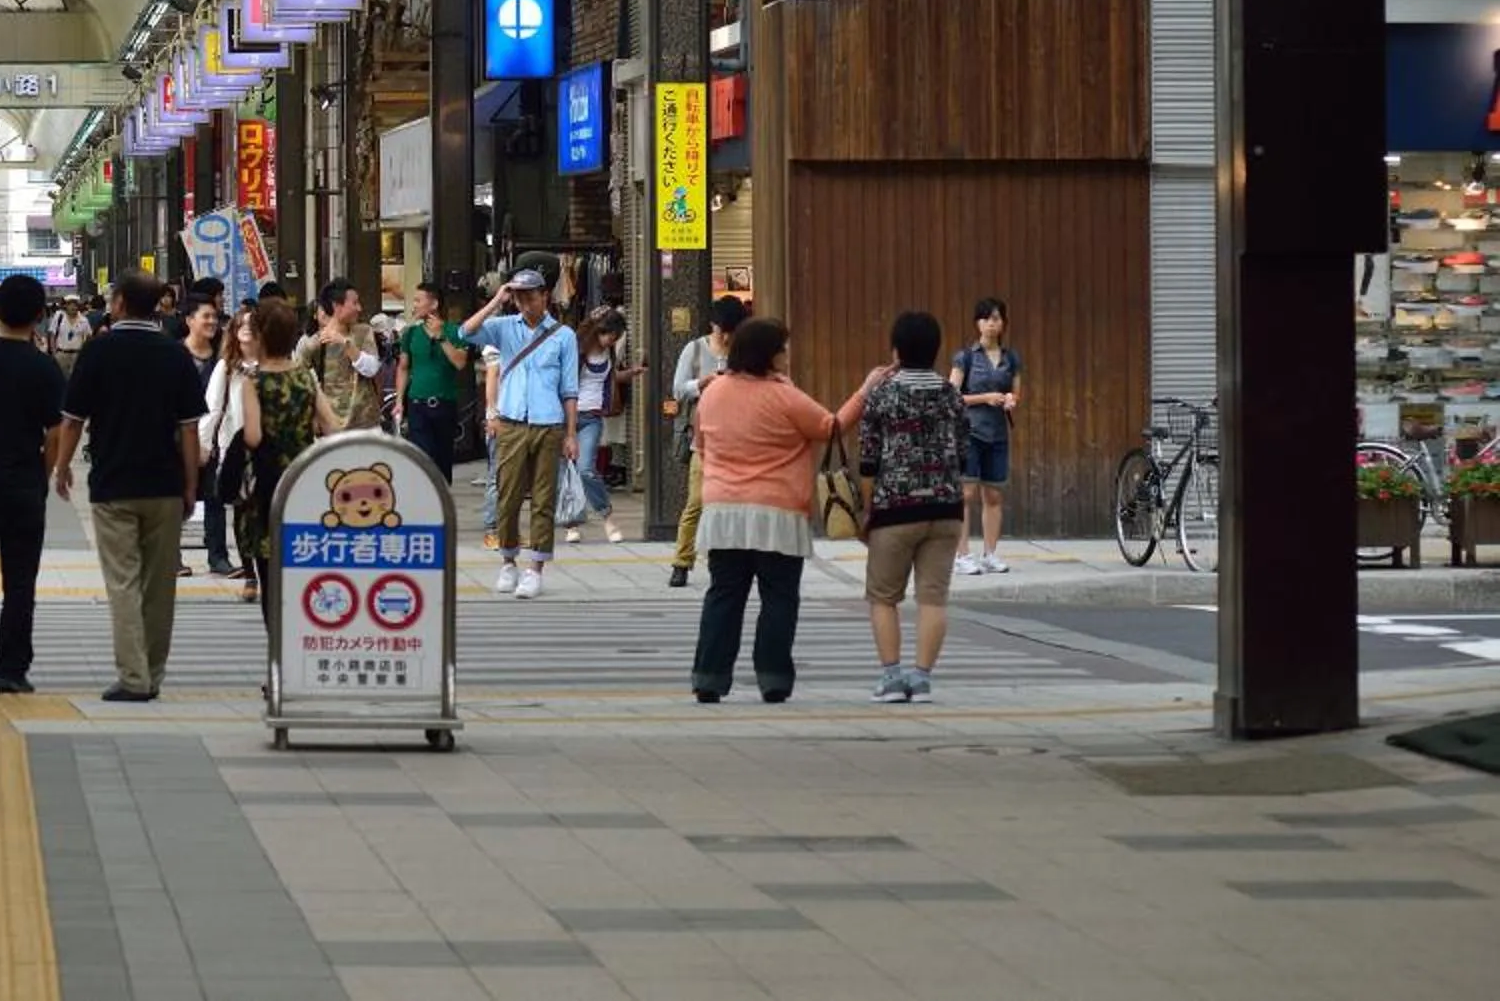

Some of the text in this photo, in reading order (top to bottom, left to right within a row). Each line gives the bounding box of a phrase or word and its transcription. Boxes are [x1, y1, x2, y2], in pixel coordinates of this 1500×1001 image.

[291, 531, 435, 565] 歩行者専用
[303, 635, 423, 652] 防犯カメラ作動中
